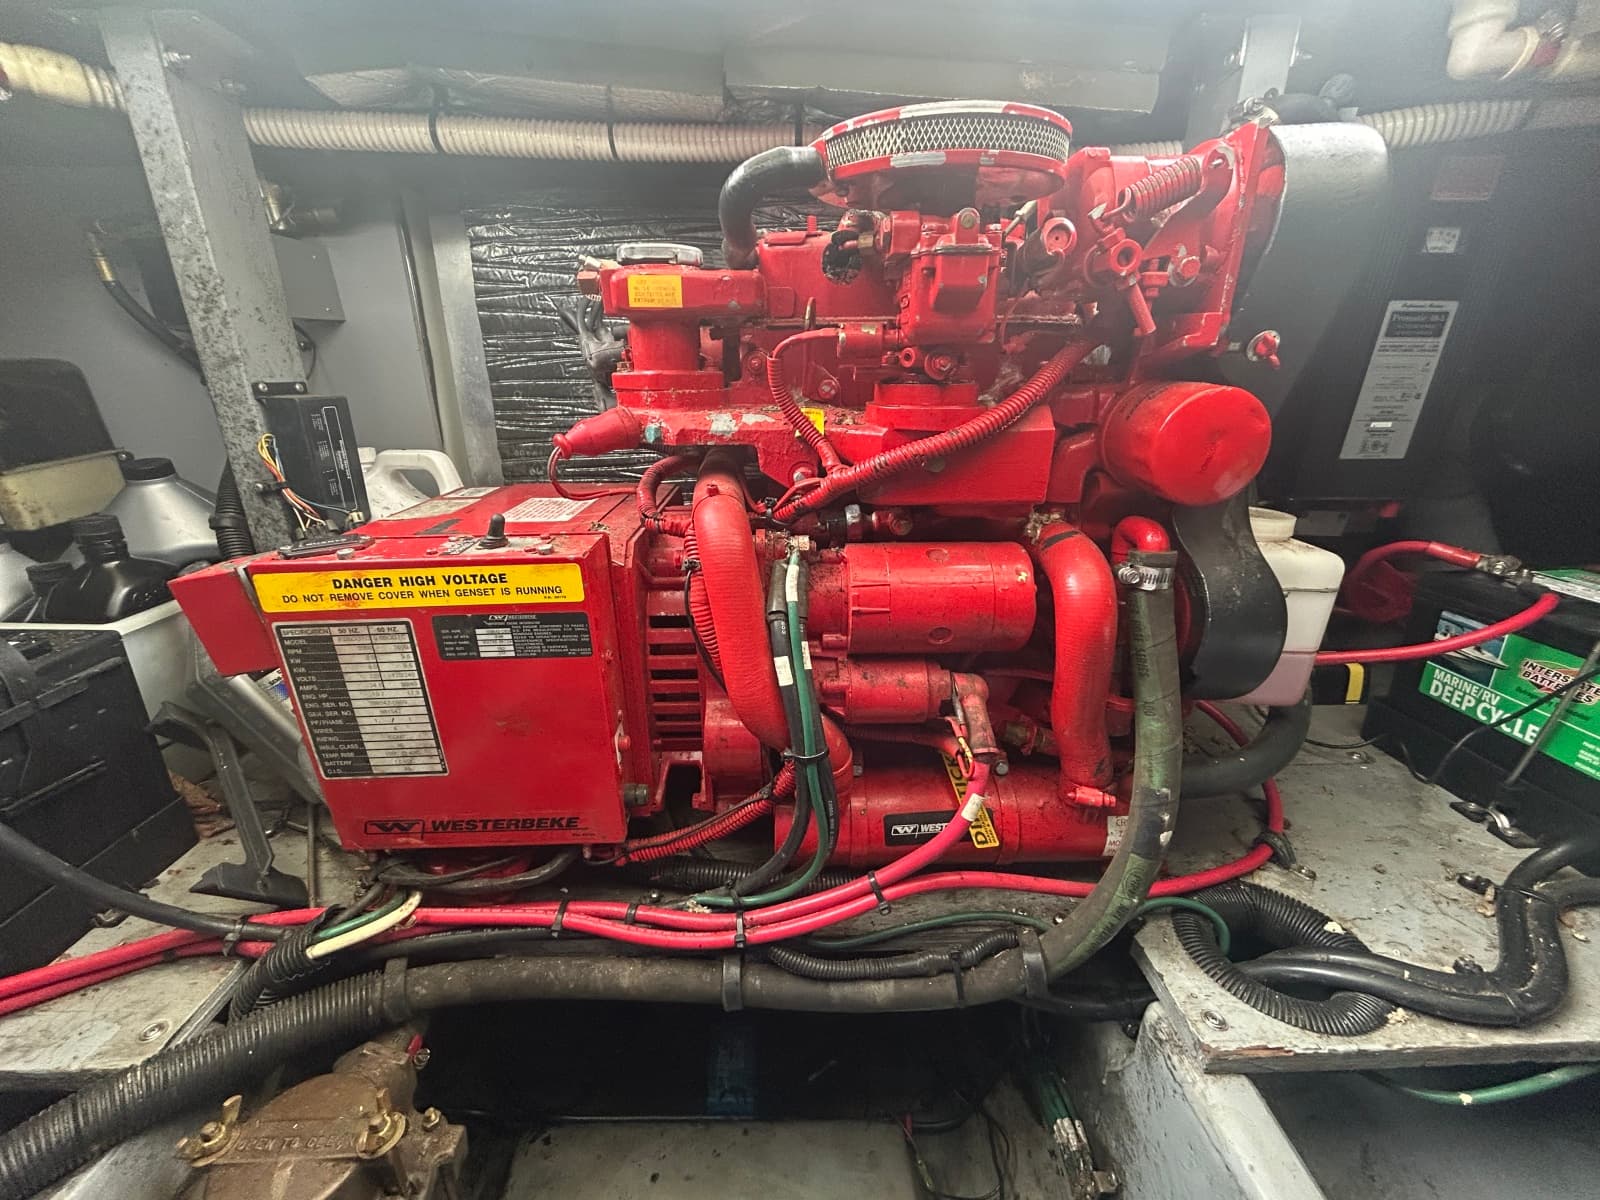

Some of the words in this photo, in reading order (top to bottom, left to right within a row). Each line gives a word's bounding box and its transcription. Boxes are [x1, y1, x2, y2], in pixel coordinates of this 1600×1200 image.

[332, 577, 393, 589] DANGER
[399, 575, 436, 587] HIGH
[442, 573, 508, 585] VOLTAGE
[282, 595, 298, 603] DO
[303, 594, 324, 602] NOT
[330, 591, 374, 601] REMOVE
[378, 590, 414, 600] COVER
[418, 589, 450, 598] WHEN
[455, 587, 496, 597] GENSET
[500, 587, 511, 596] IS
[516, 585, 563, 595] RUNNING
[1429, 679, 1476, 712] DEEP
[1433, 668, 1500, 704] MARINE/RV
[1522, 670, 1594, 704] BATTEES
[432, 816, 580, 832] WESTERBEKE
